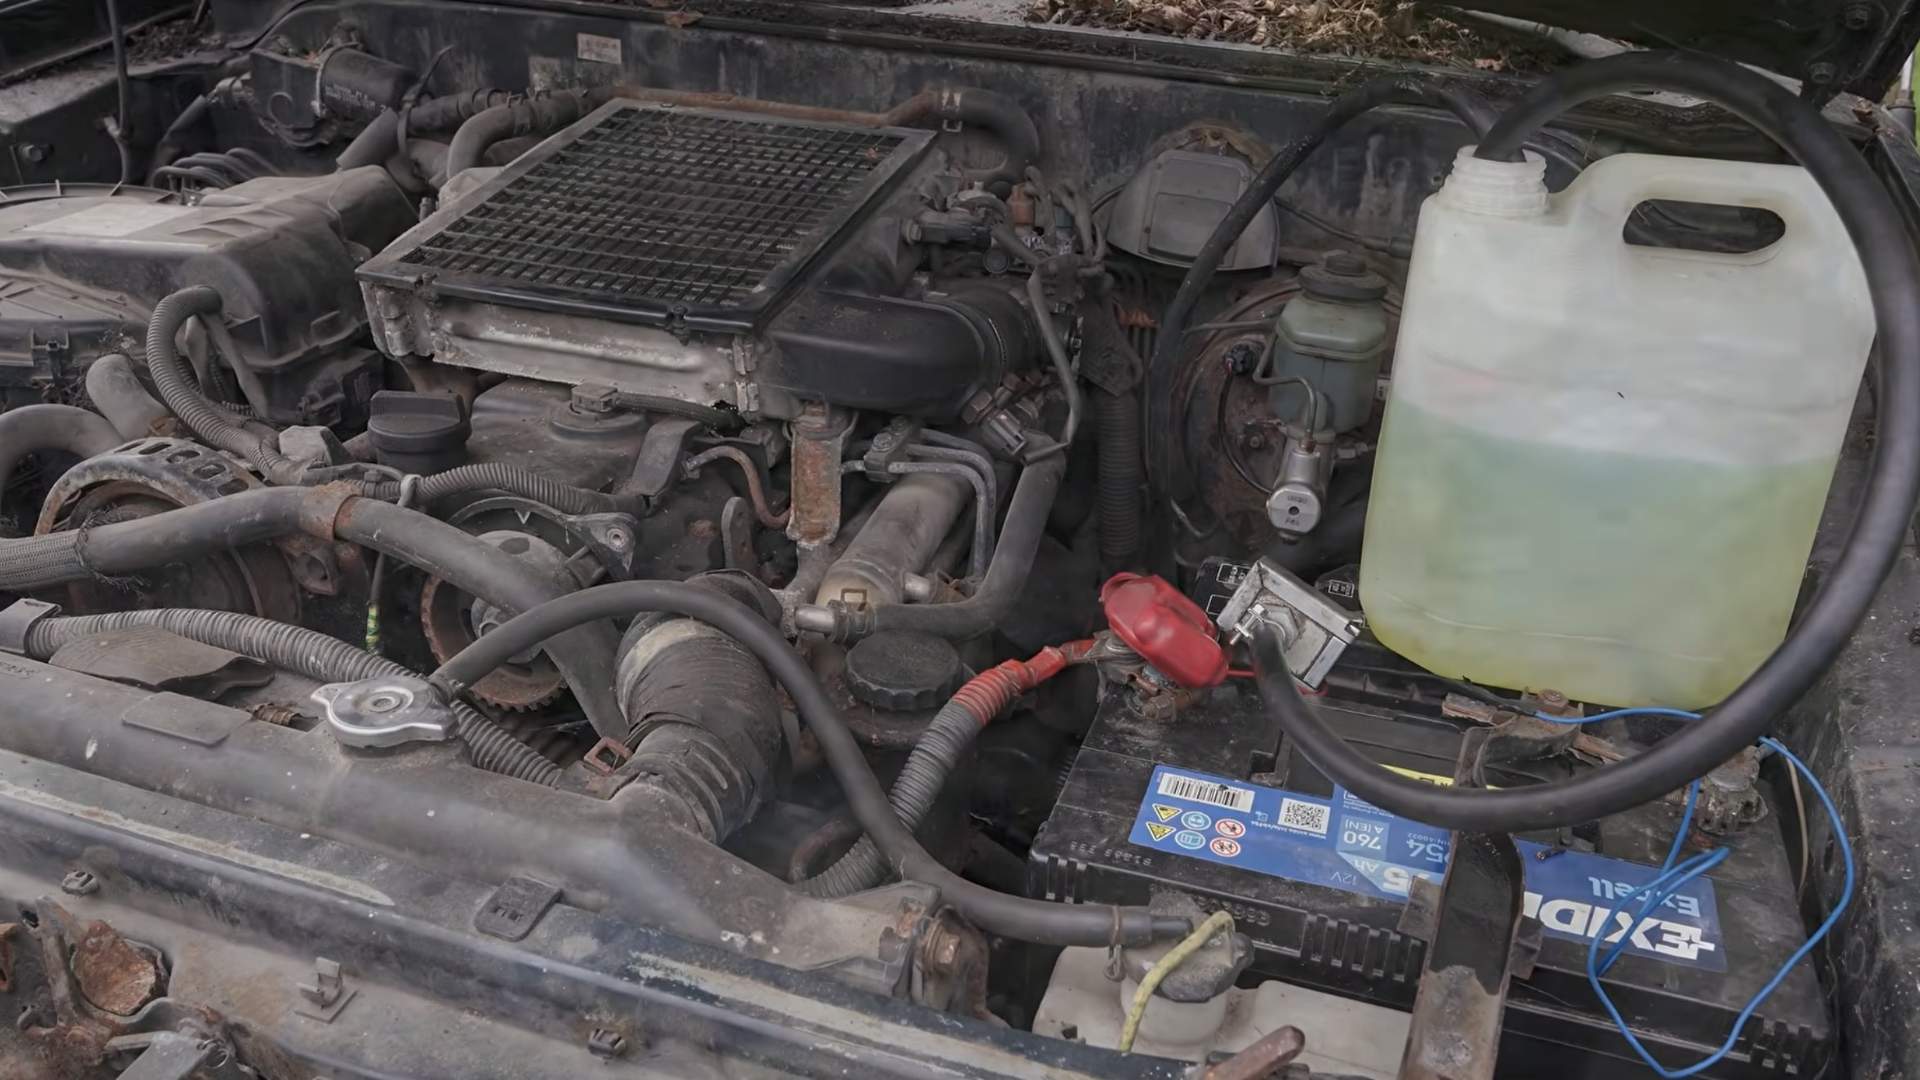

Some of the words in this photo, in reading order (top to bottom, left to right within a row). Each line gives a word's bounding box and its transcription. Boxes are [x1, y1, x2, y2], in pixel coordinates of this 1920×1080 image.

[1374, 825, 1384, 834] A
[1343, 831, 1382, 850] 760
[1330, 871, 1357, 886] 12V
